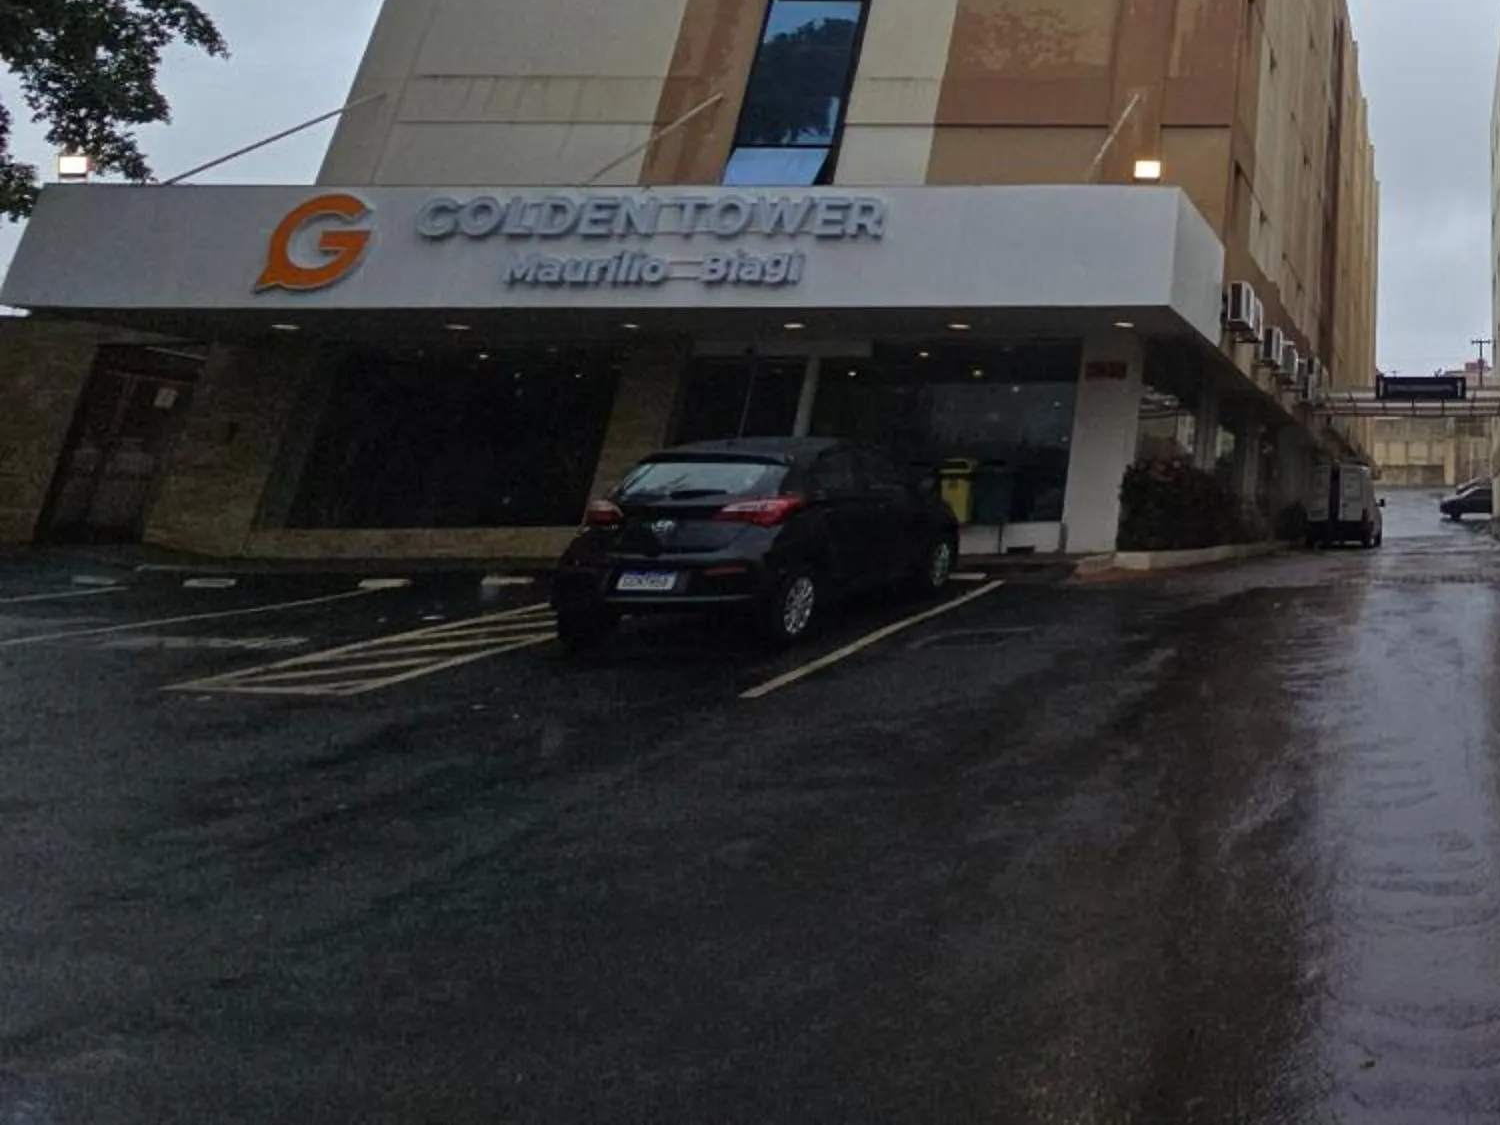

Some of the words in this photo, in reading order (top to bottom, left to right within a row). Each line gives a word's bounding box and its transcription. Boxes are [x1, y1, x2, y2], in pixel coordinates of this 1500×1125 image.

[415, 195, 660, 241] GOLDEN
[675, 195, 886, 241] TOWER
[253, 194, 376, 293] G
[502, 250, 669, 288] Maurilio
[701, 249, 804, 286] Biagi
